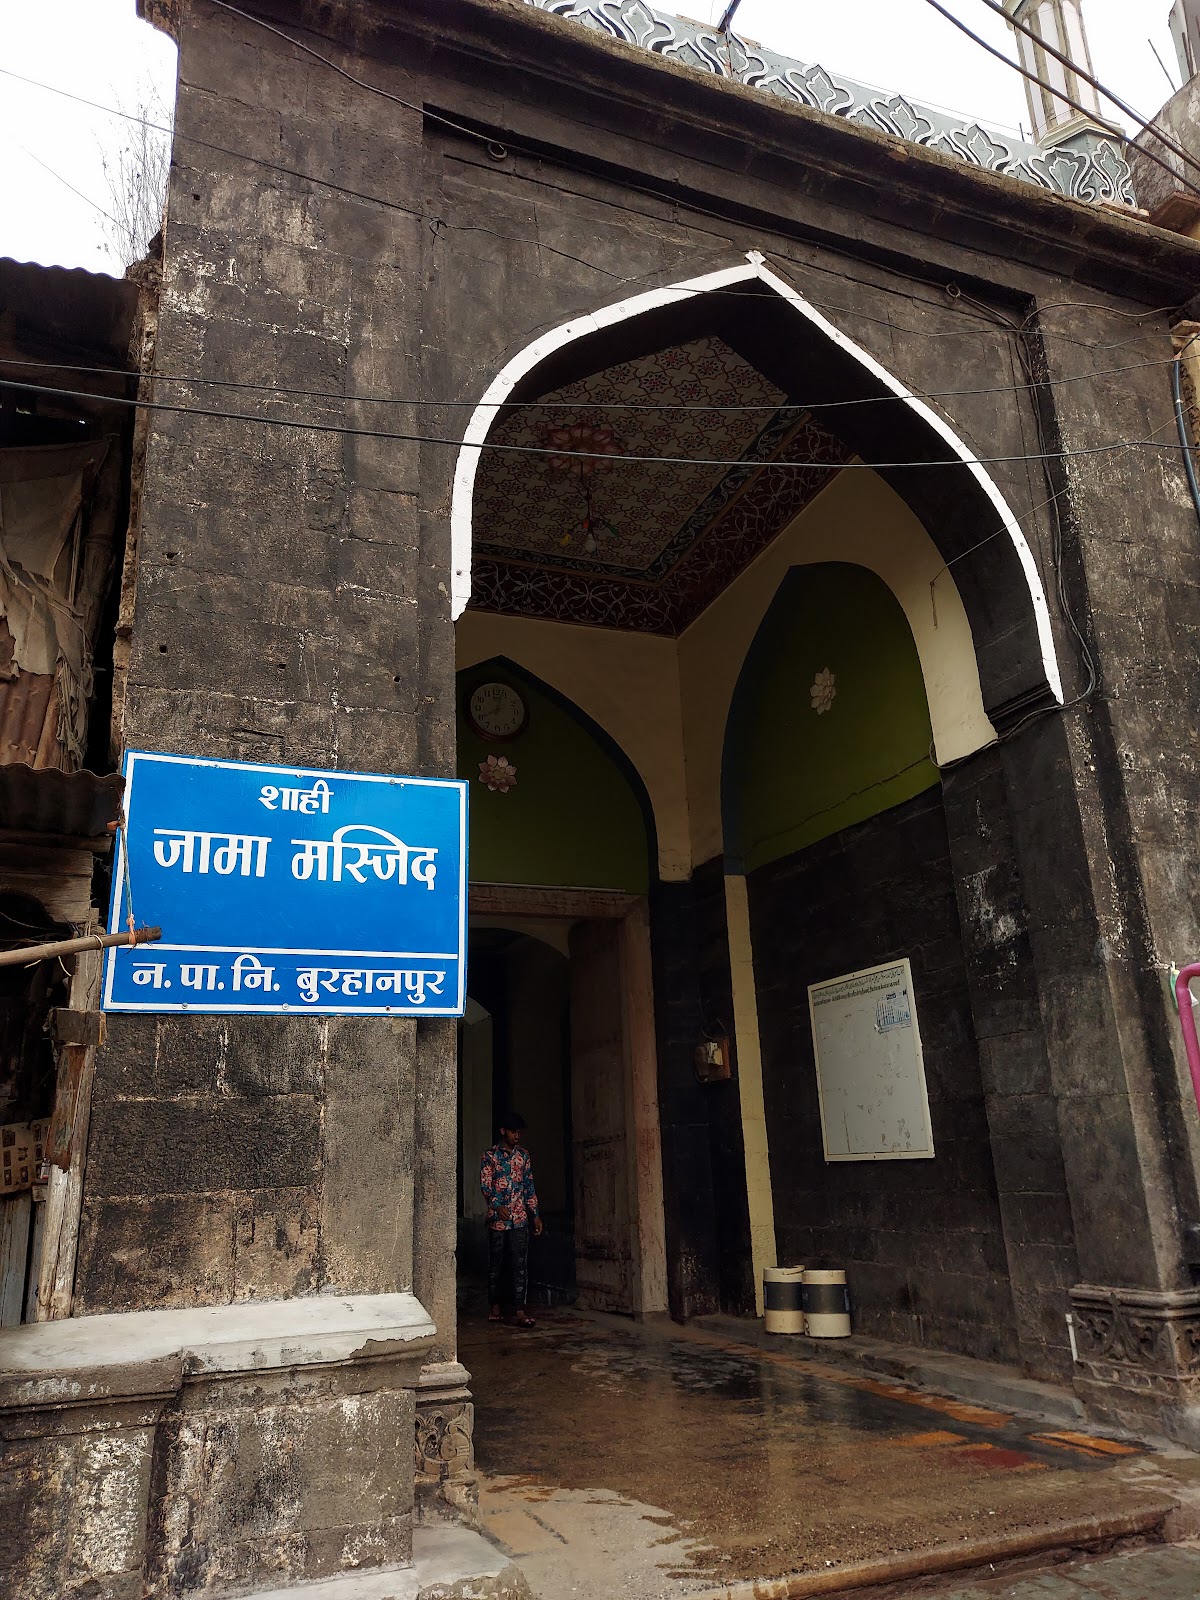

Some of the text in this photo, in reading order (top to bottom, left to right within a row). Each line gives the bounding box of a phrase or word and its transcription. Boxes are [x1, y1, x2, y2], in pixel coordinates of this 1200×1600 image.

[258, 779, 334, 815] शाही
[153, 824, 438, 890] जामा मस्जिद
[295, 967, 446, 1004] बुरहानपुर
